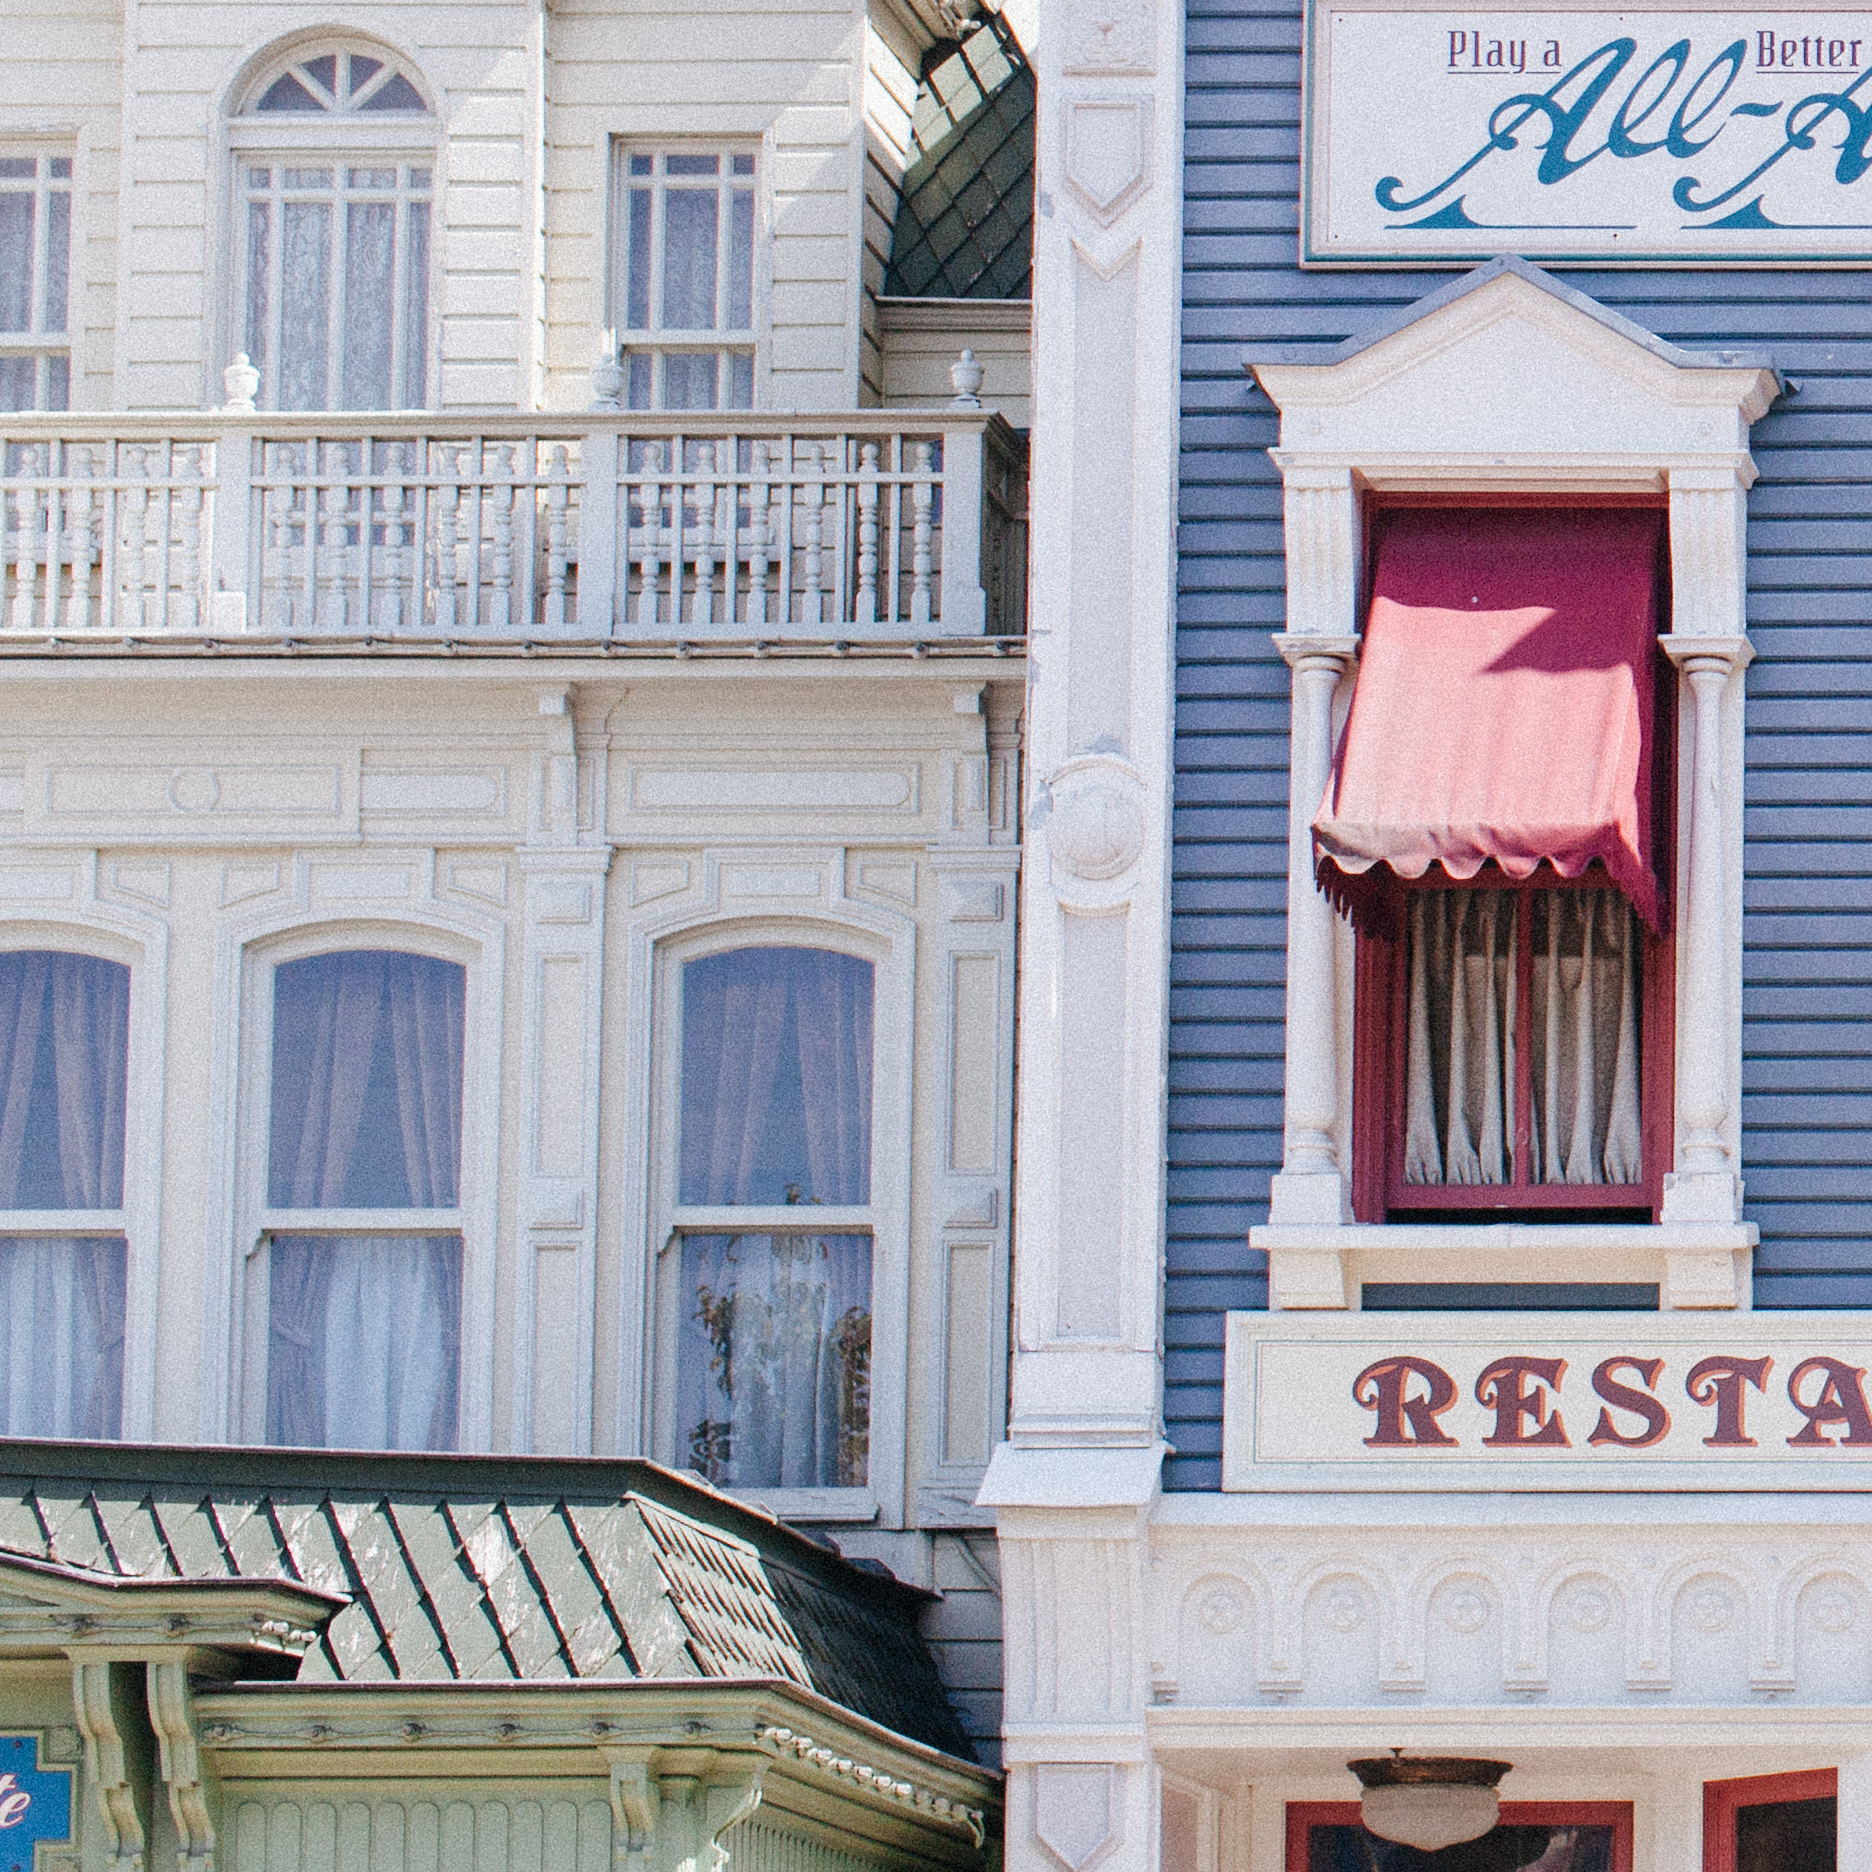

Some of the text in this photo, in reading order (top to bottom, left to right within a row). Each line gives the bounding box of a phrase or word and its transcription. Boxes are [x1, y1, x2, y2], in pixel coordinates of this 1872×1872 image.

[1447, 30, 1527, 73] Play
[1543, 38, 1563, 68] a
[1756, 30, 1862, 68] Better
